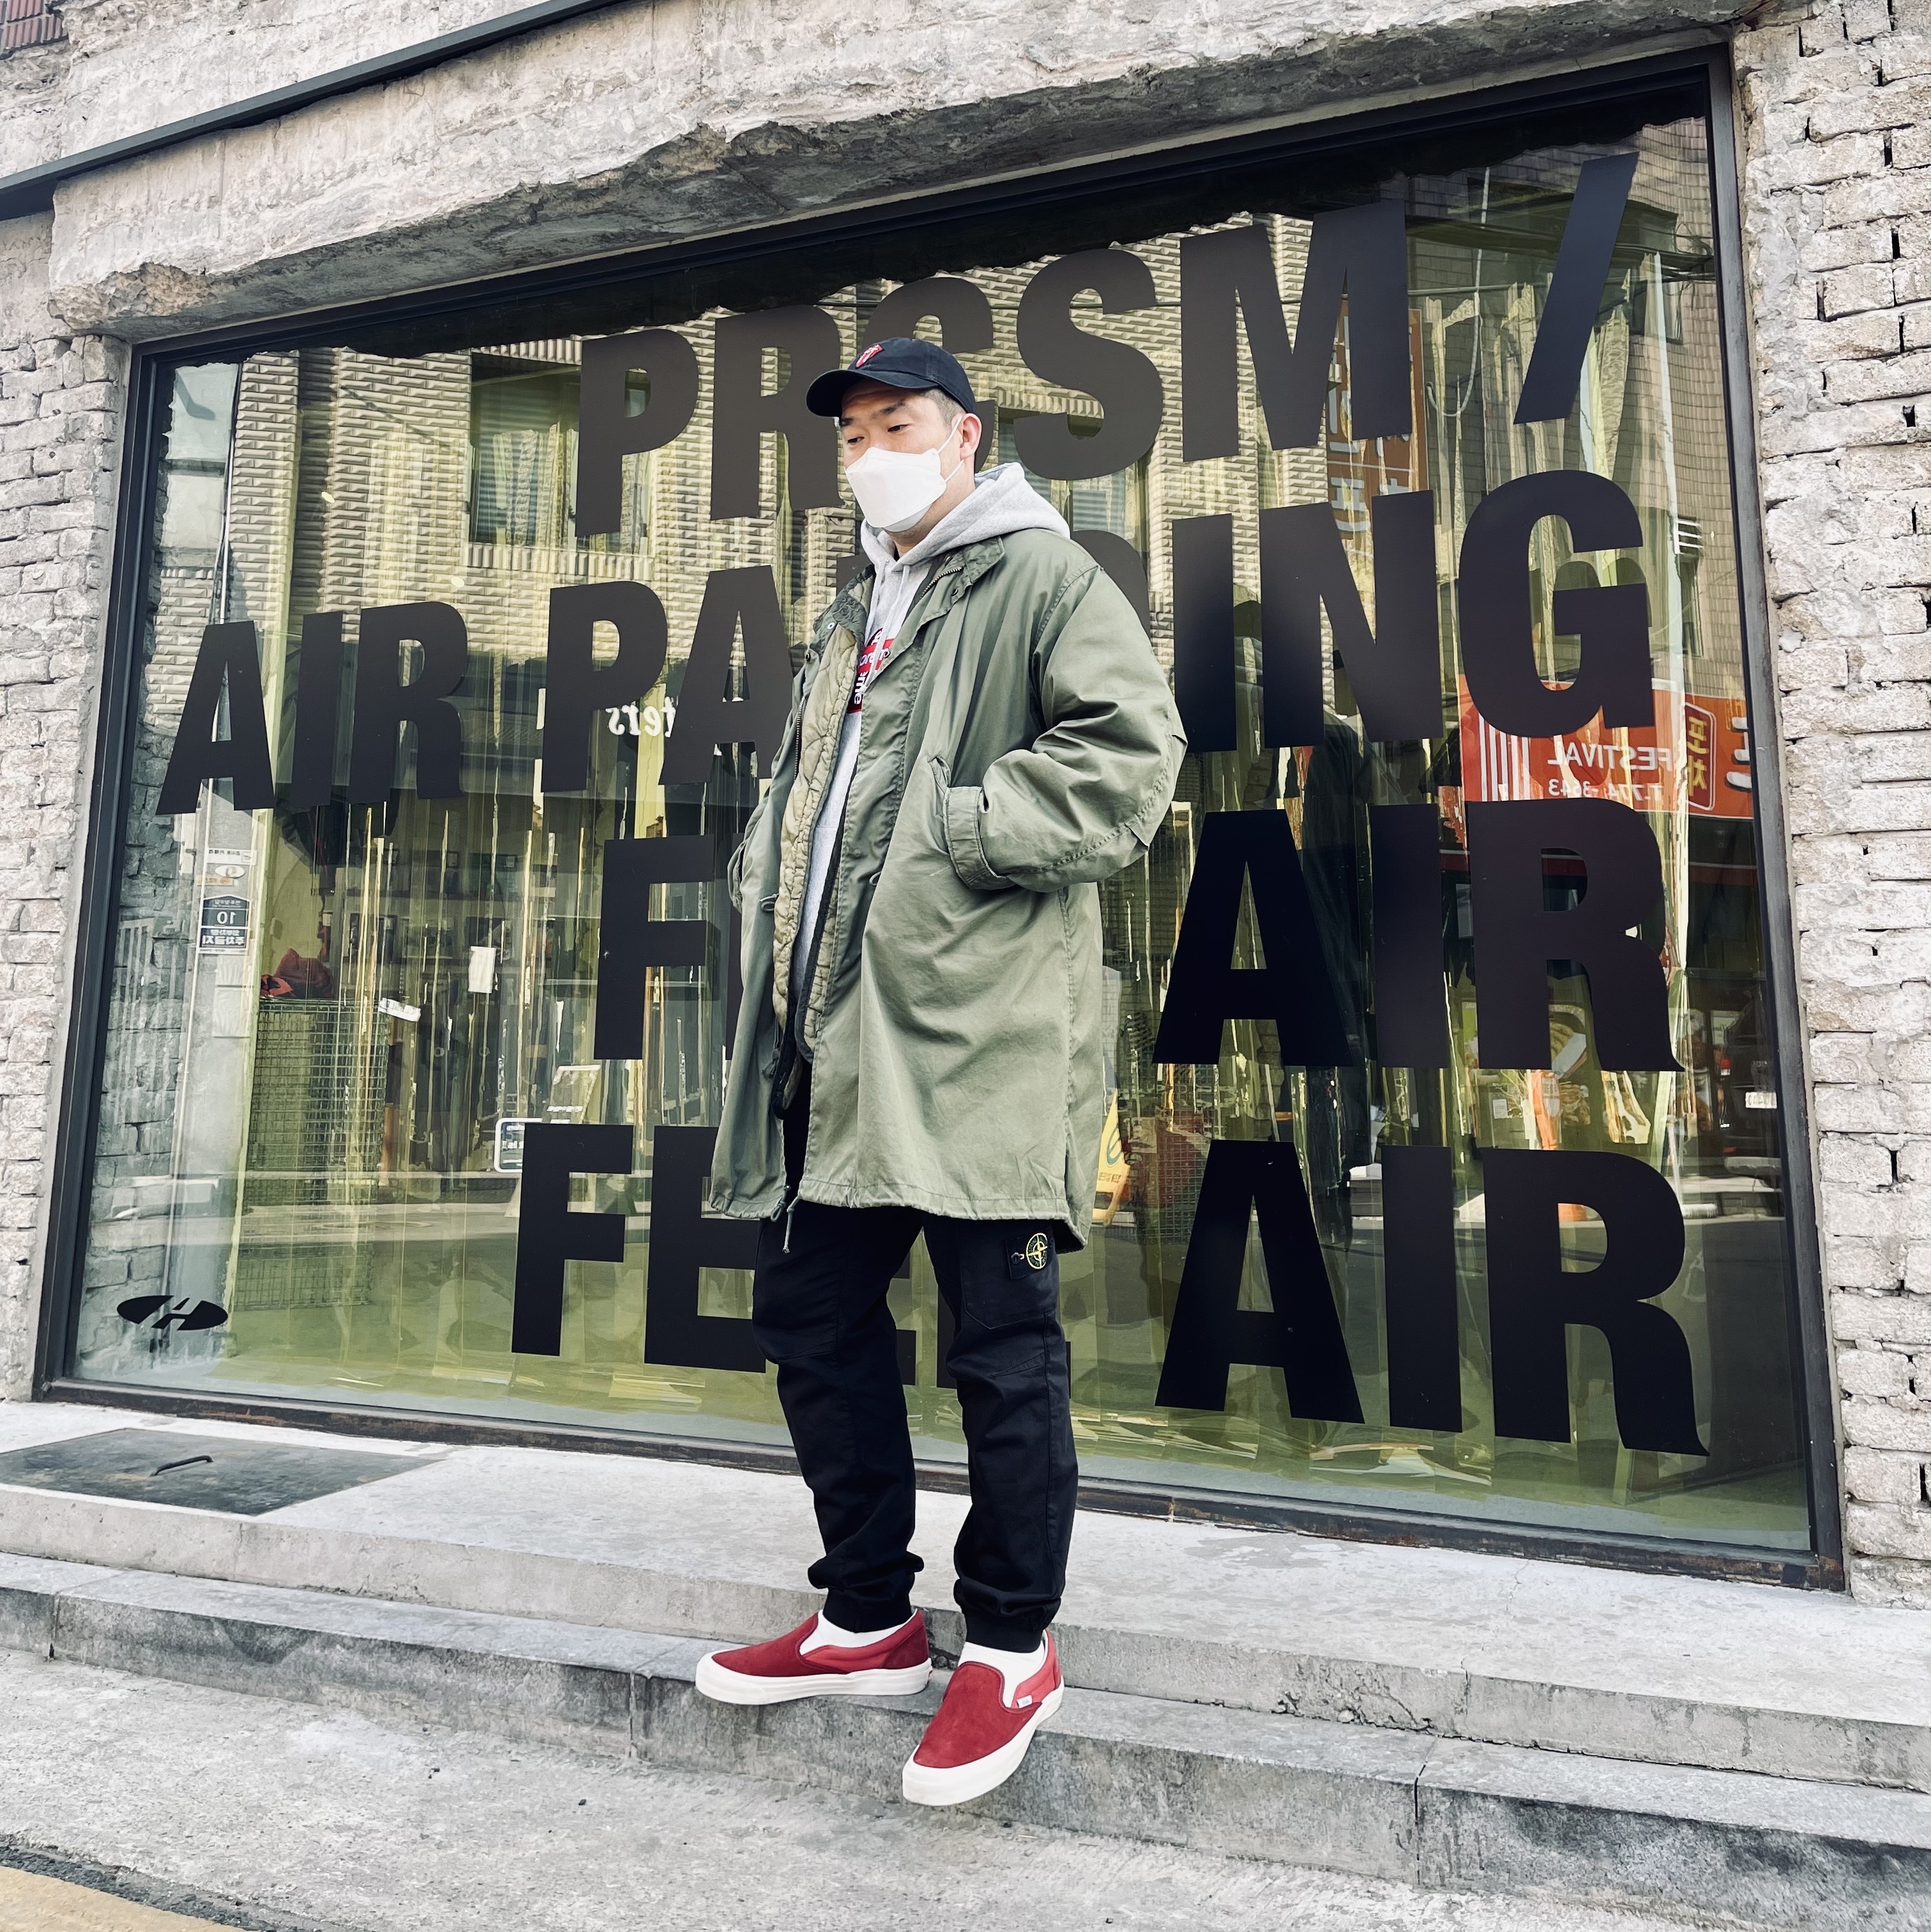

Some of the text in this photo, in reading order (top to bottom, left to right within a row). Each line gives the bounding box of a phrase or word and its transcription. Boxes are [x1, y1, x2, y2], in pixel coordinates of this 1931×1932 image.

[155, 469, 1655, 816] AIR PAING
[1152, 800, 1685, 1072] AIR
[1154, 1139, 1711, 1457] AIR
